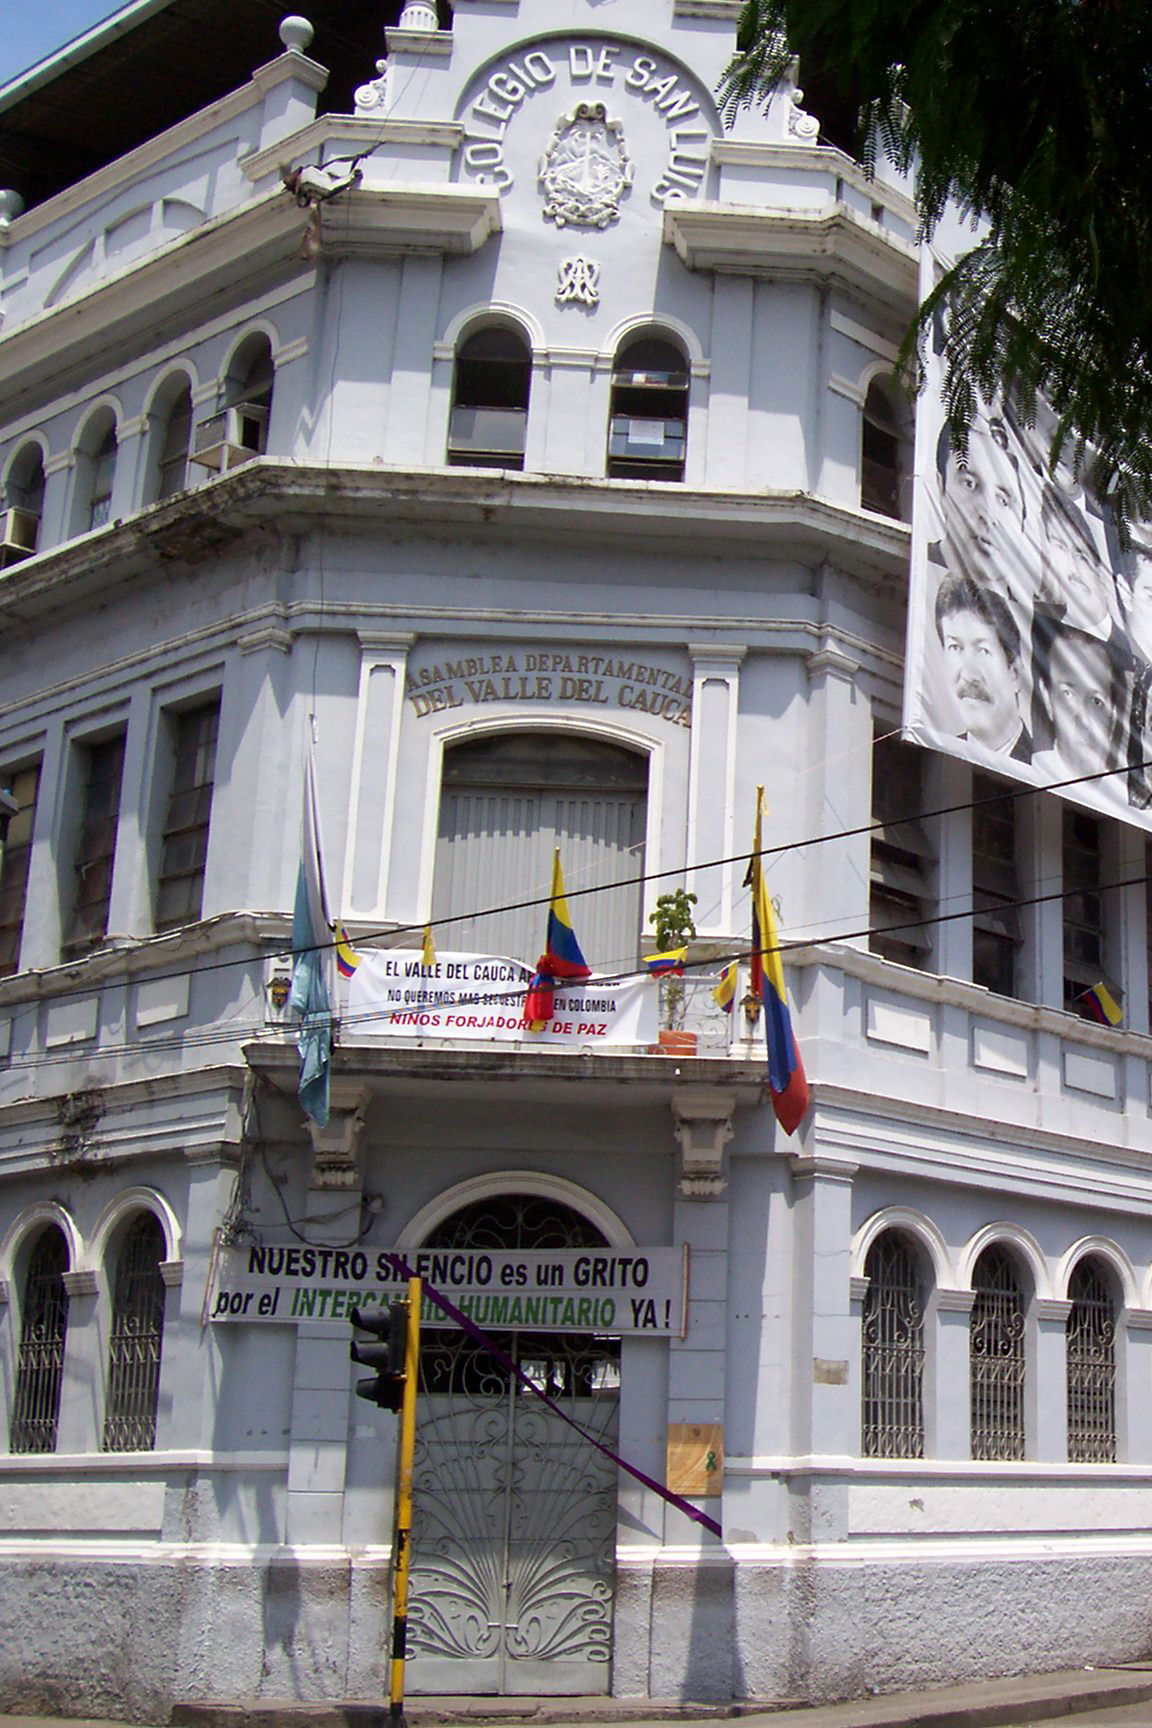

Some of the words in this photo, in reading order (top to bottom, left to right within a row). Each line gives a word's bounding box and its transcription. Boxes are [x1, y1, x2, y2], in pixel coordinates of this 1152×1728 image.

[569, 45, 620, 80] DE
[624, 57, 700, 121] SAN
[464, 51, 557, 189] COLEGIO
[650, 129, 709, 202] LUIS
[405, 654, 519, 693] ASAMBLEA
[525, 654, 694, 698] DEPARTAMENTAL
[409, 684, 464, 719] DEL
[464, 676, 552, 703] VALLE
[559, 677, 608, 704] DEL
[616, 684, 692, 729] CAUCA
[385, 961, 400, 977] EL
[405, 962, 442, 979] VALLE
[446, 963, 469, 980] DEL
[473, 964, 515, 982] CAUCA
[387, 989, 402, 1002] NO
[404, 990, 456, 1005] QUEREMOS
[554, 998, 566, 1011] EN
[569, 999, 617, 1013] COLOMBIA
[552, 1021, 573, 1034] DE
[577, 1023, 608, 1036] PAZ
[248, 1246, 367, 1280] NUESTRO
[500, 1263, 528, 1286] es
[536, 1264, 564, 1287] un
[574, 1256, 649, 1288] GRITO
[214, 1289, 255, 1319] por
[257, 1287, 280, 1316] el
[459, 1294, 616, 1328] HUMANITARIO
